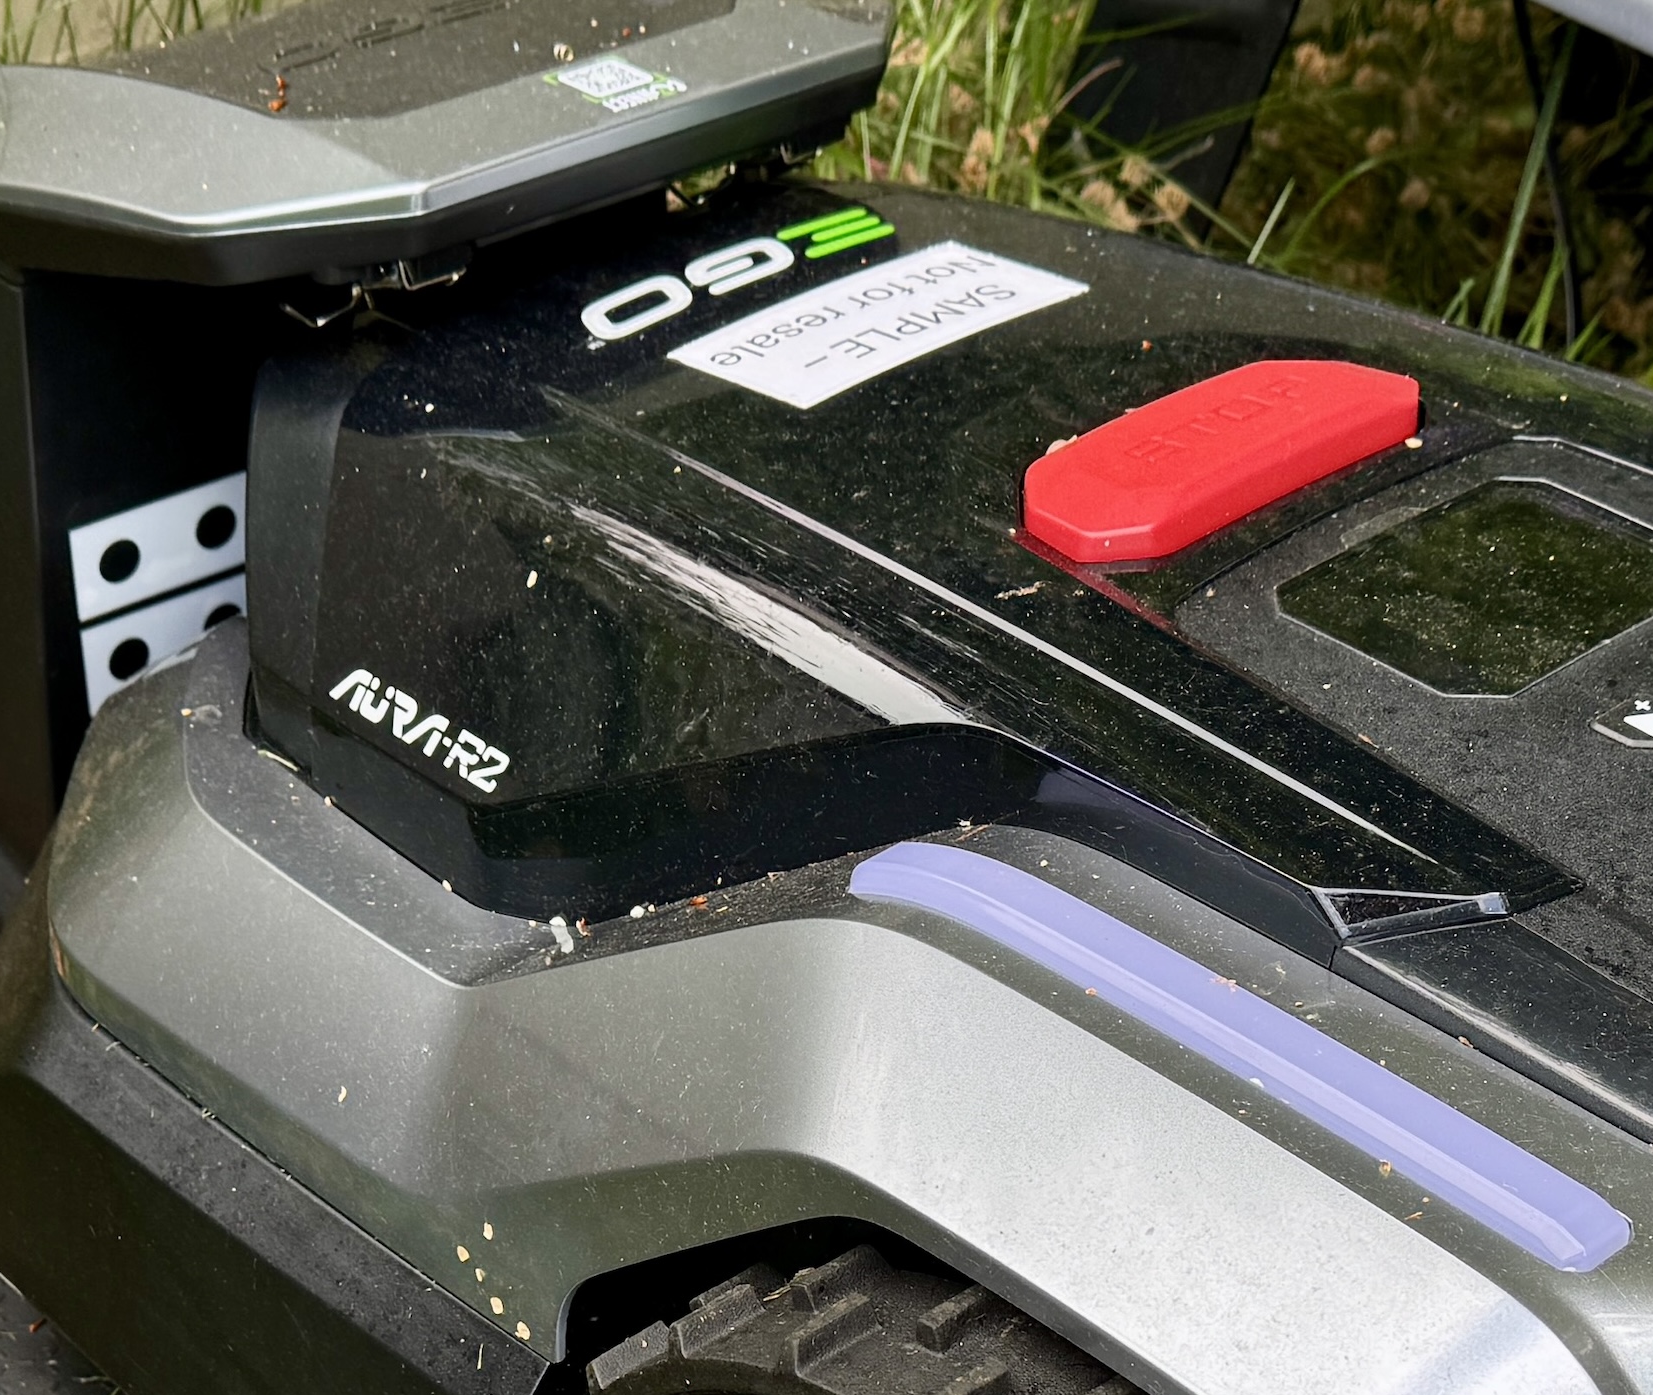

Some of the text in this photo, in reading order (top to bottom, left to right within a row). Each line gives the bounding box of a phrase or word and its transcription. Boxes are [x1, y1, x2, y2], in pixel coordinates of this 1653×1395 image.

[581, 207, 895, 340] EGO
[709, 254, 997, 367] Not for resale
[829, 283, 1017, 359] SAMPLE
[1123, 373, 1308, 464] STOP
